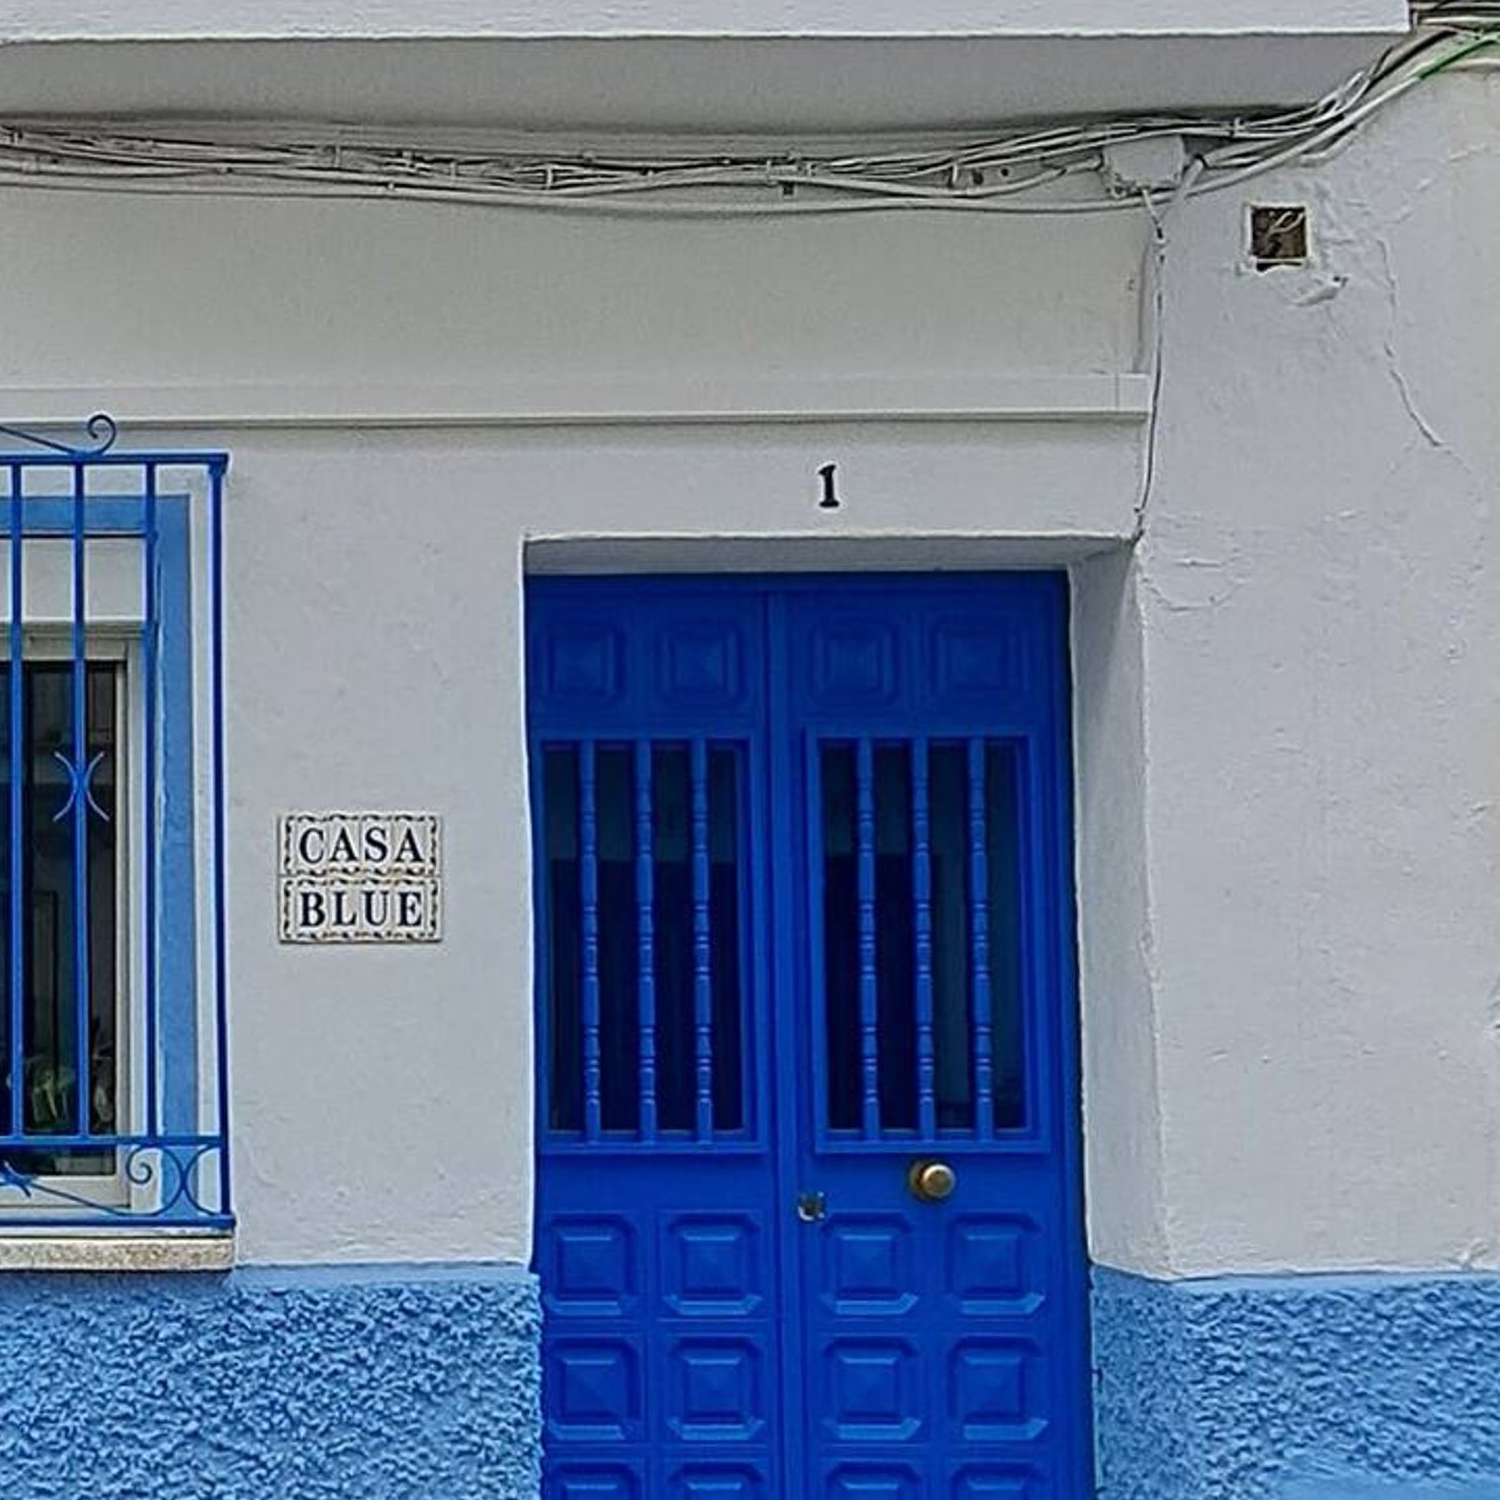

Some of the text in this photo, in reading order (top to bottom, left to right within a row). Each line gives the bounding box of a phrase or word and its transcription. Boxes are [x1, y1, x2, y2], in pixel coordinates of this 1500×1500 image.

[818, 464, 841, 508] 1
[299, 826, 424, 864] CASA
[300, 890, 422, 927] BLUE
